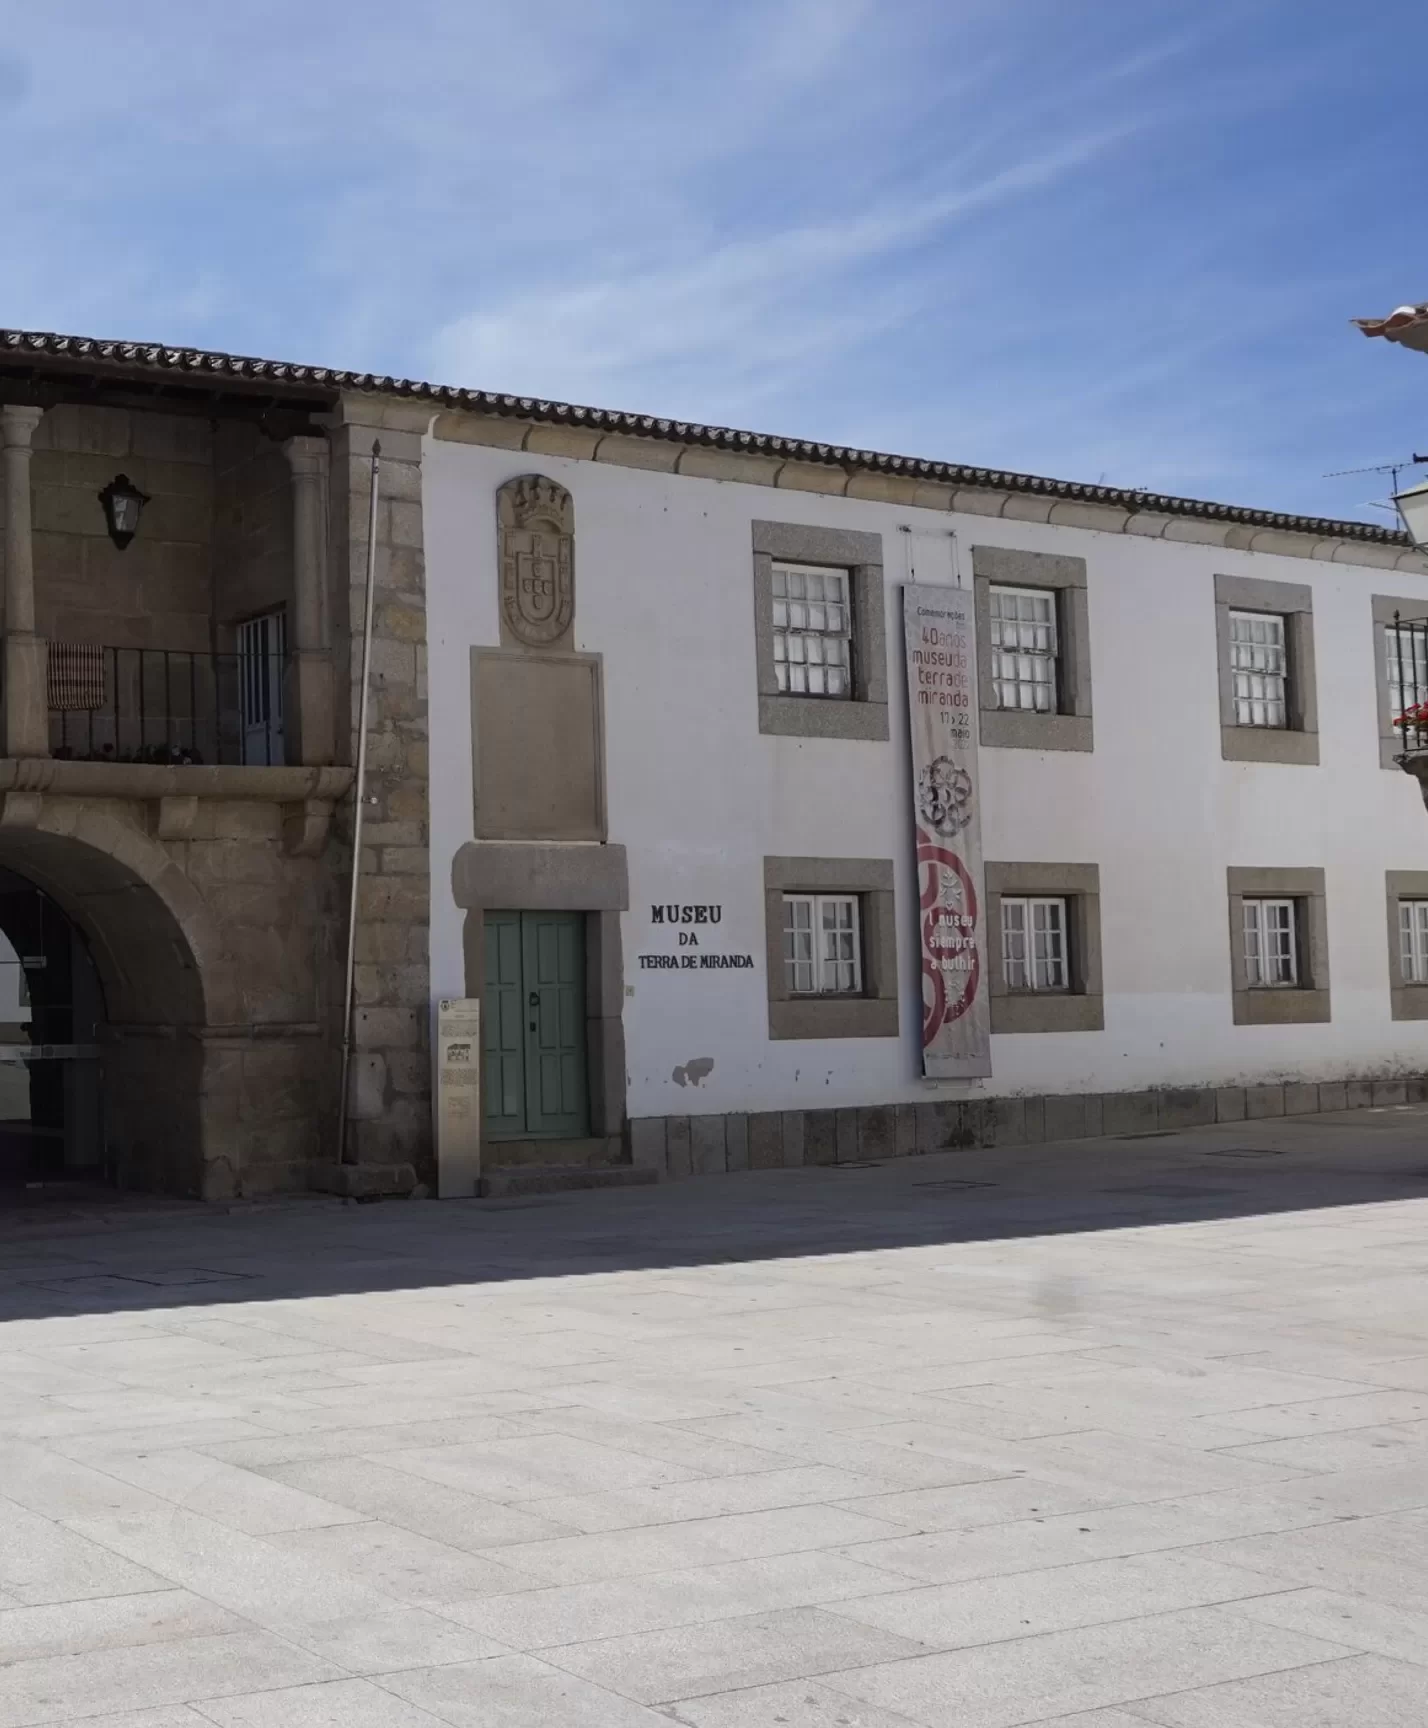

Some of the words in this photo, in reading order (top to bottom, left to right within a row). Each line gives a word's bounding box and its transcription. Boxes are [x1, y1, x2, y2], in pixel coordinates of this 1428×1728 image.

[958, 712, 969, 726] 22
[950, 726, 970, 739] maio
[651, 904, 722, 924] MUSEU
[678, 931, 699, 946] DA
[929, 935, 975, 953] siempre
[638, 954, 679, 969] TERRA
[681, 954, 698, 969] DE
[699, 954, 755, 969] MIRANDA
[930, 958, 937, 970] a
